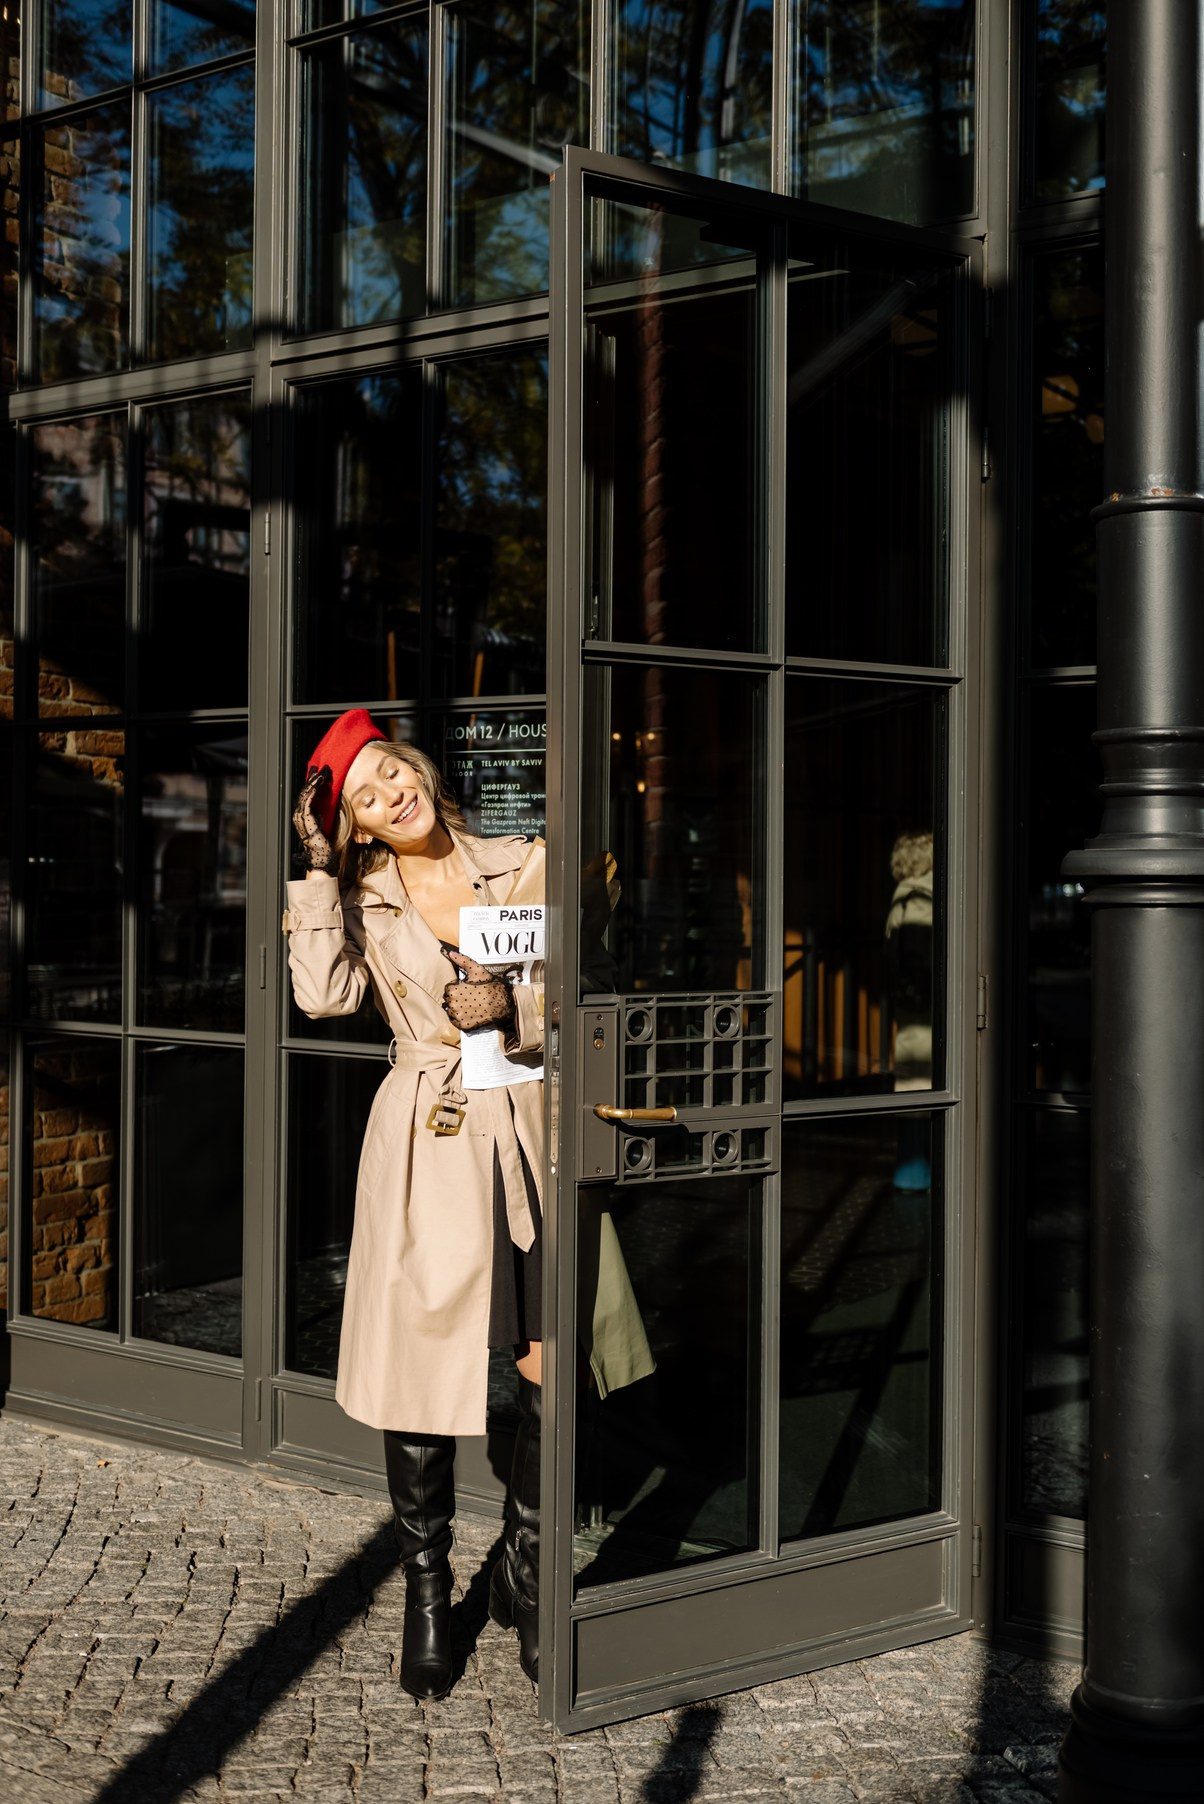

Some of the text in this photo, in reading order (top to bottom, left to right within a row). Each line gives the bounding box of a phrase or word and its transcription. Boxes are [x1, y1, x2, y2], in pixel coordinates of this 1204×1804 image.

[446, 726, 477, 741] ДОМ
[480, 725, 493, 739] 12
[511, 759, 520, 767] BY
[521, 759, 543, 767] SAVIV
[481, 783, 521, 792] ЦИФЕРГАУЗ
[500, 792, 530, 801] цифровой
[480, 809, 517, 817] ZIFERGAUZ
[491, 818, 517, 827] Gazprom
[480, 826, 521, 834] Transformation
[499, 909, 543, 921] PARIS
